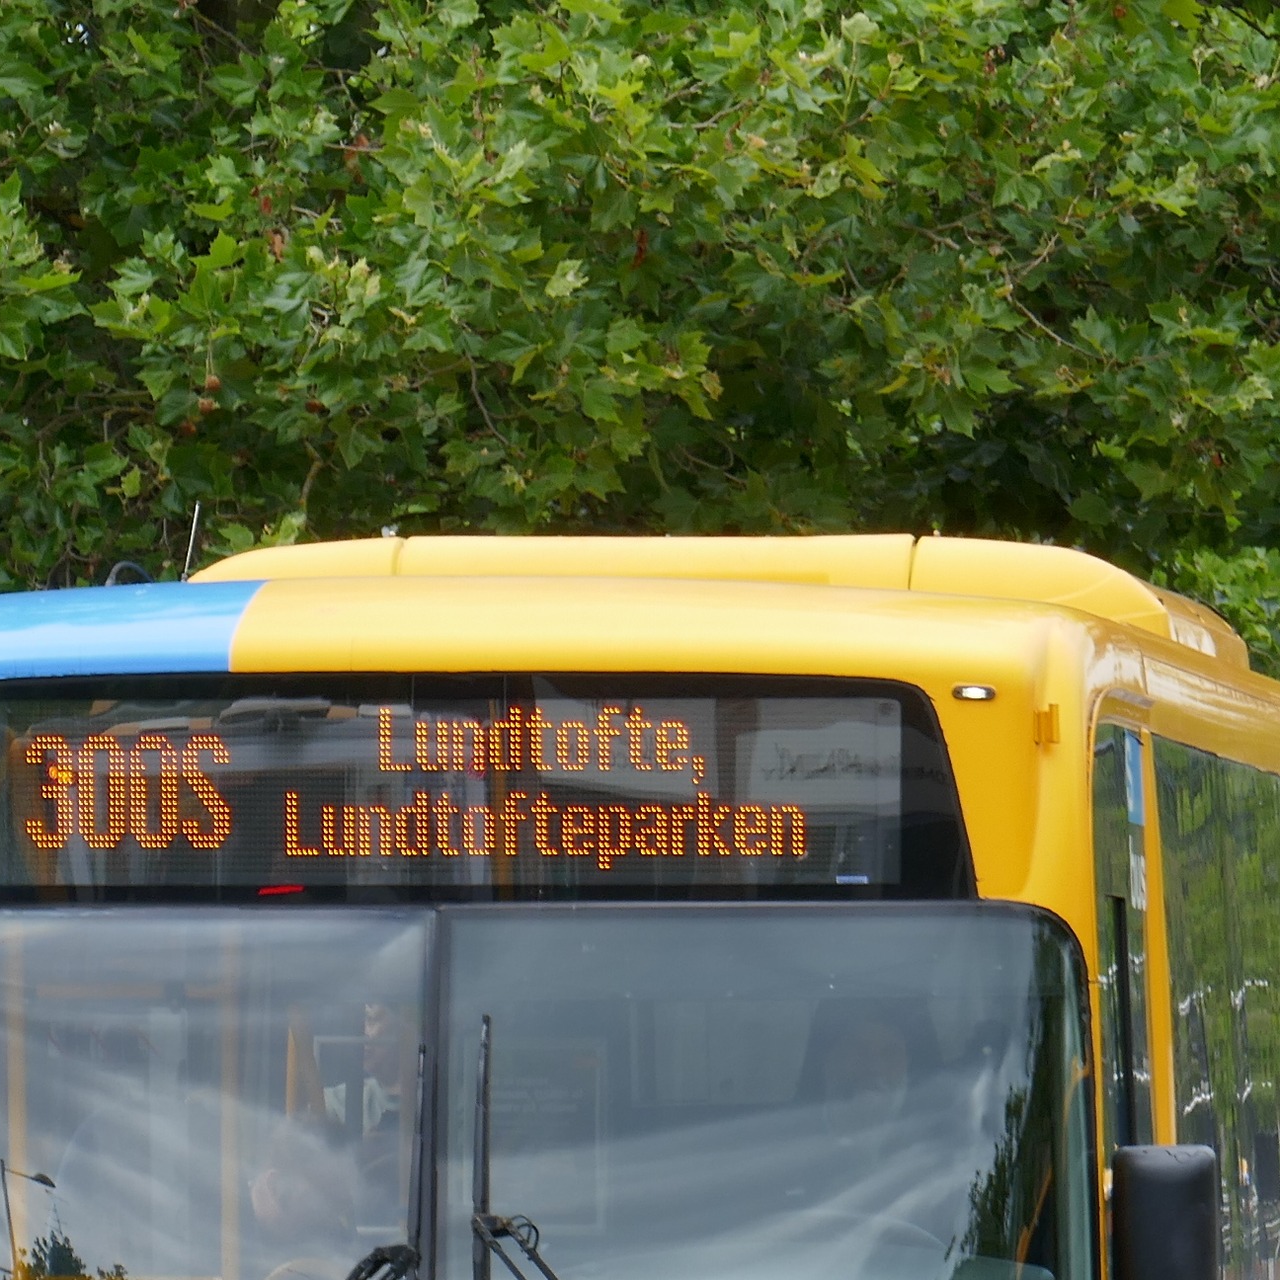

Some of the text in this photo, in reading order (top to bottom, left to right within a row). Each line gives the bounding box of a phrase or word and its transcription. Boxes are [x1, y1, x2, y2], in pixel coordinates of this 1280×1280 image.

[377, 705, 706, 785] Lundtofte,
[25, 734, 232, 850] 300S
[284, 790, 807, 871] Lundtofteparken
